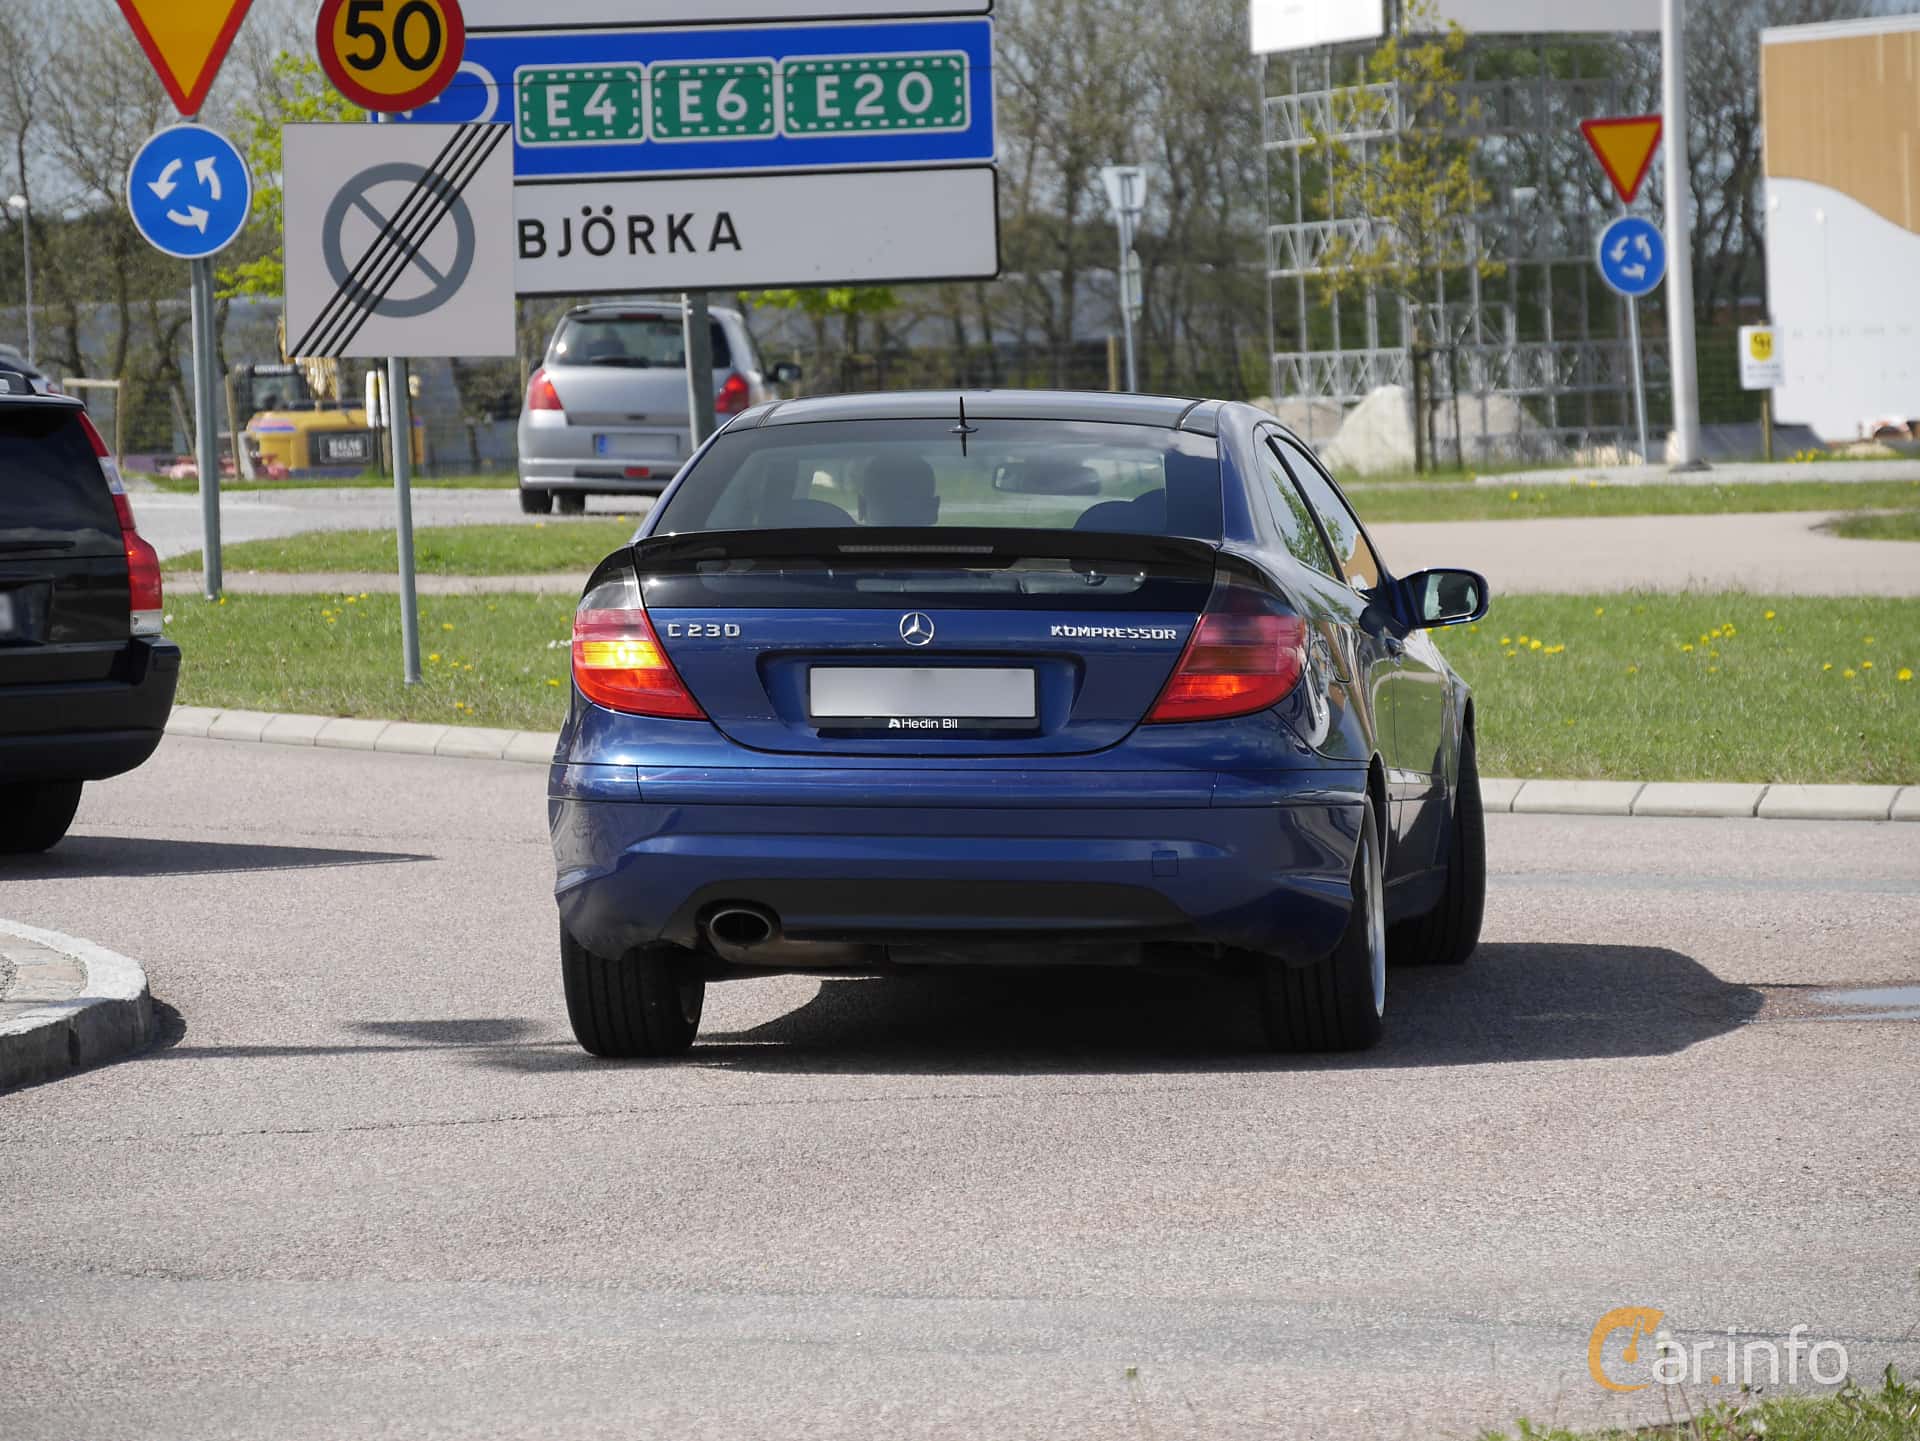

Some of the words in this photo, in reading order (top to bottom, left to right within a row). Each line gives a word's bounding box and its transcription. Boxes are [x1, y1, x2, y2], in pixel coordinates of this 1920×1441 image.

[345, 0, 442, 71] 50
[545, 82, 618, 127] E4
[678, 78, 749, 123] E6
[815, 70, 934, 118] E20
[516, 204, 744, 260] BJÖRKA
[667, 623, 682, 638] C
[687, 623, 741, 638] 230
[1050, 624, 1178, 641] KOMPRESSOR
[901, 717, 940, 730] Hedin
[942, 717, 959, 730] Bil
